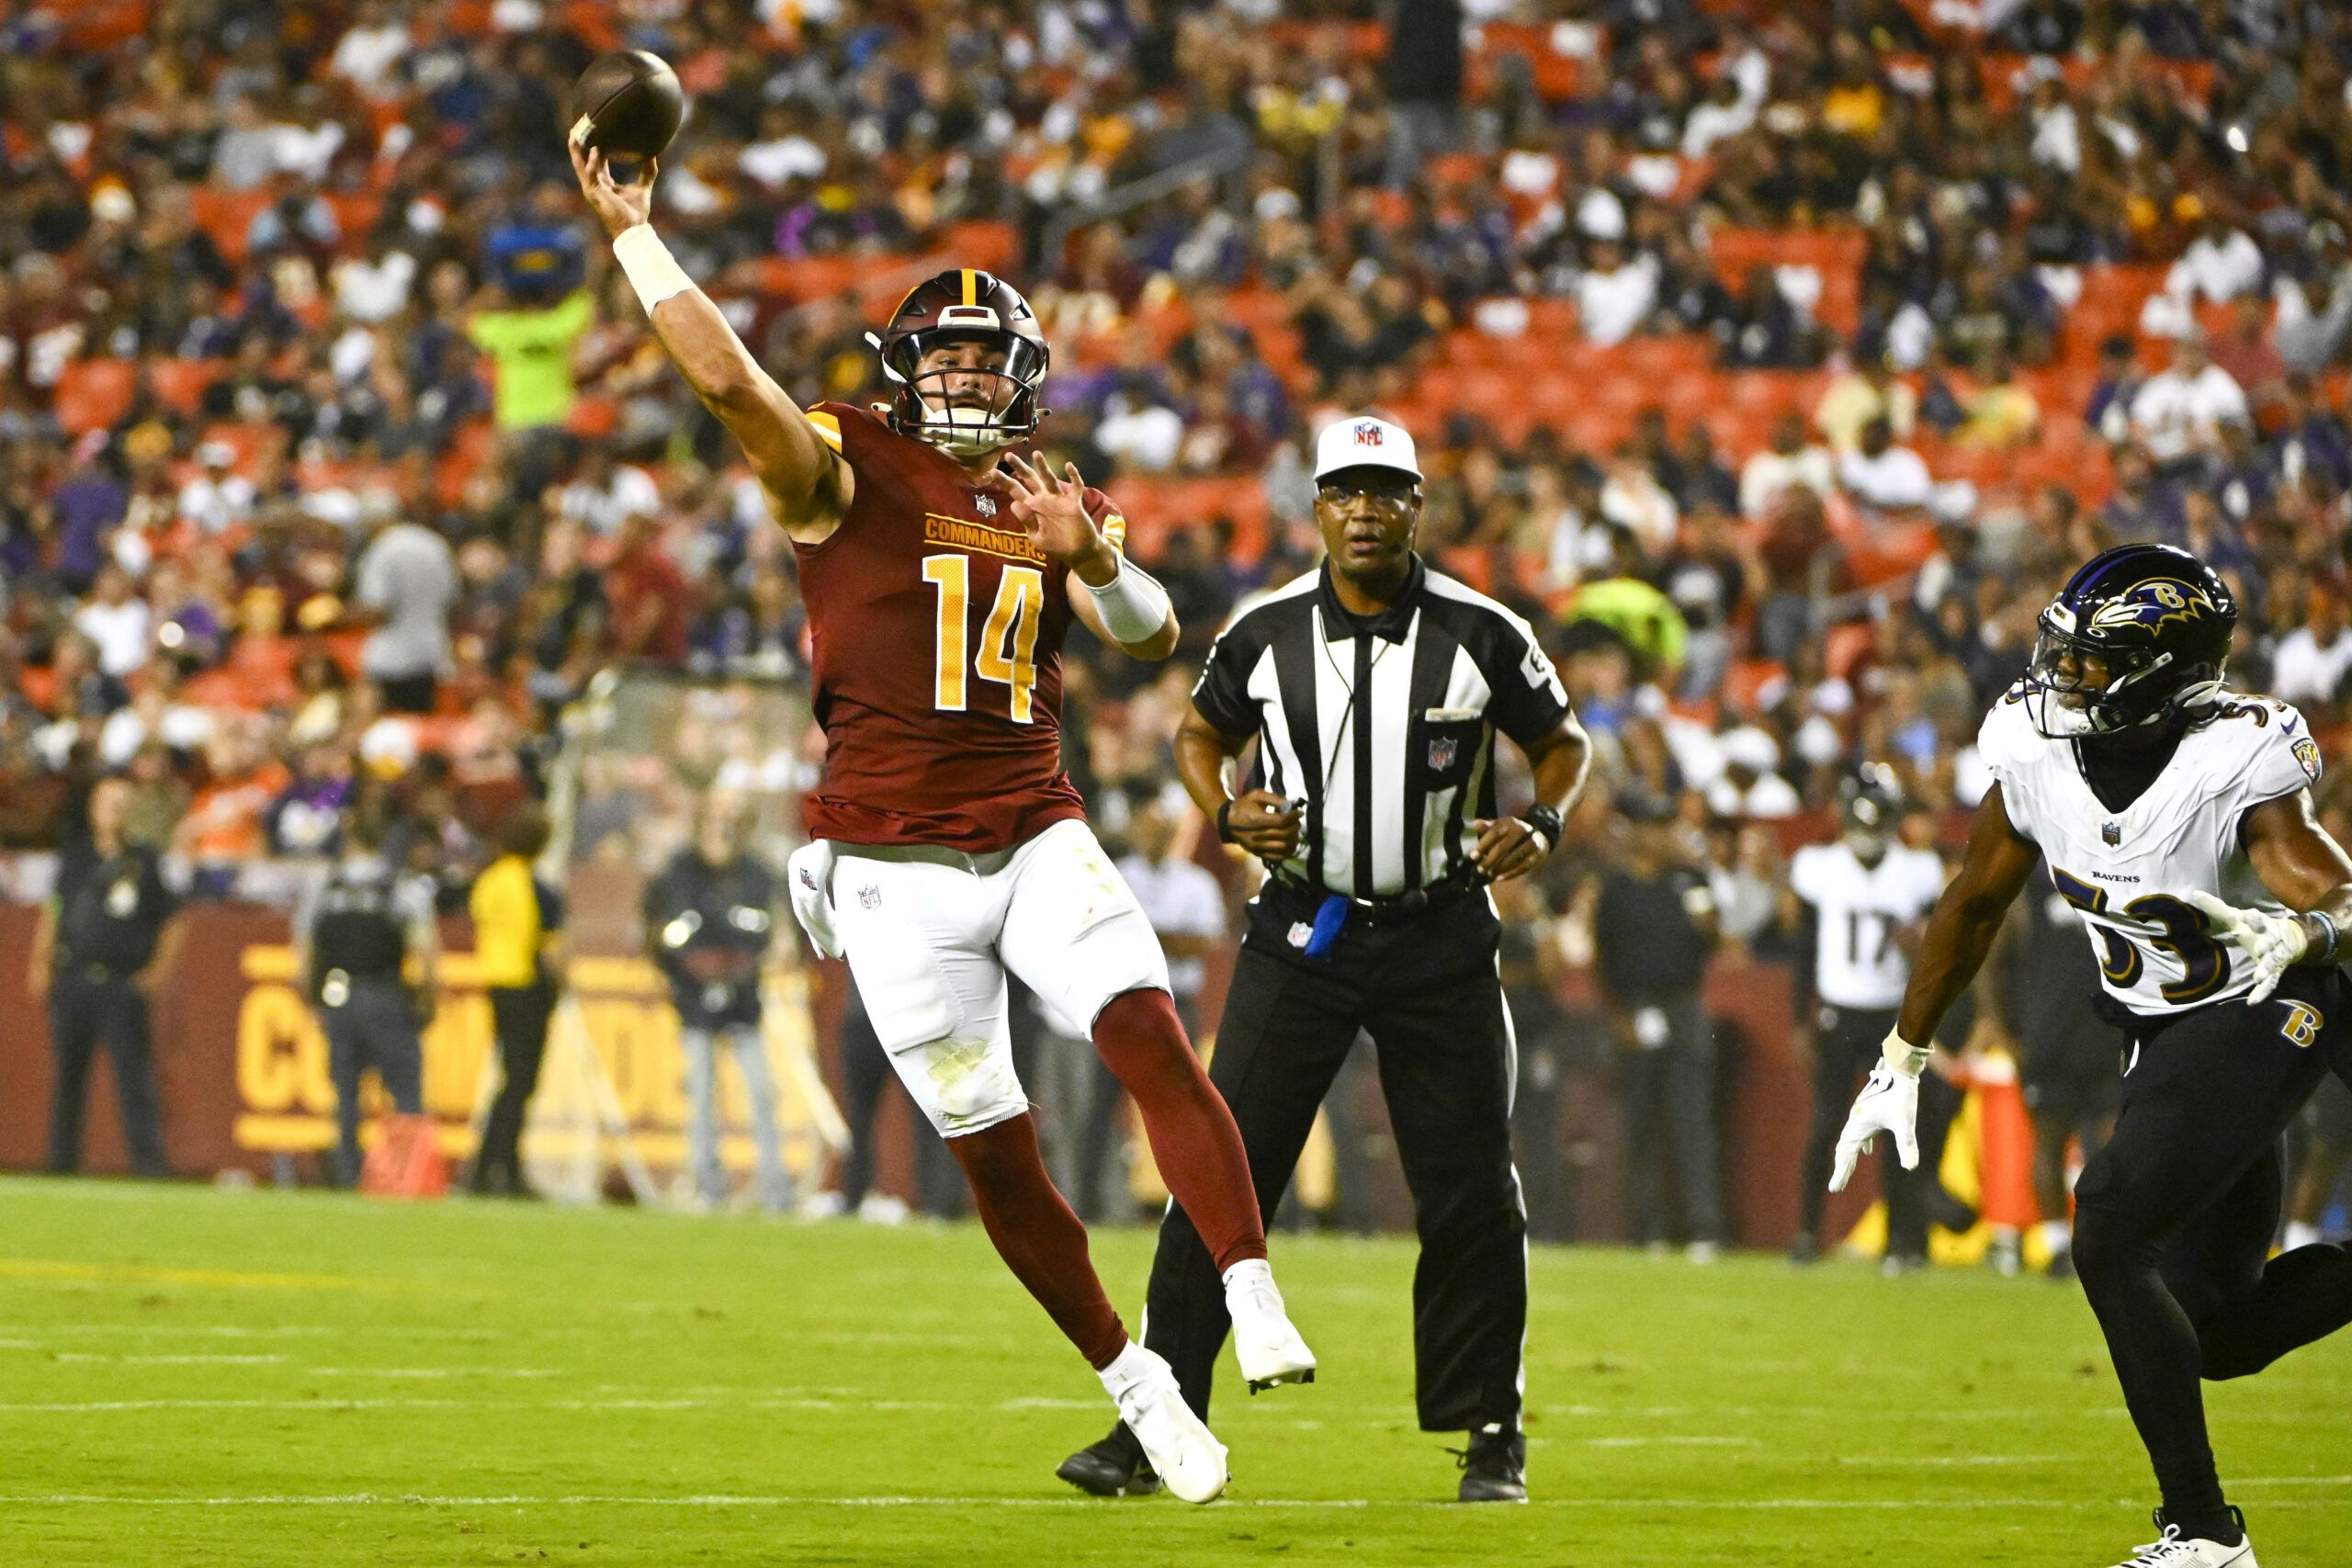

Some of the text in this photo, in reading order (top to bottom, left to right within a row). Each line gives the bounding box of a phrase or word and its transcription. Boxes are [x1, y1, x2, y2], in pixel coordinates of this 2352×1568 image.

[1357, 431, 1383, 446] NFL
[922, 554, 1044, 724] 14
[2092, 871, 2141, 884] RAVENS
[863, 896, 878, 907] NFL
[2052, 864, 2232, 1006] 53
